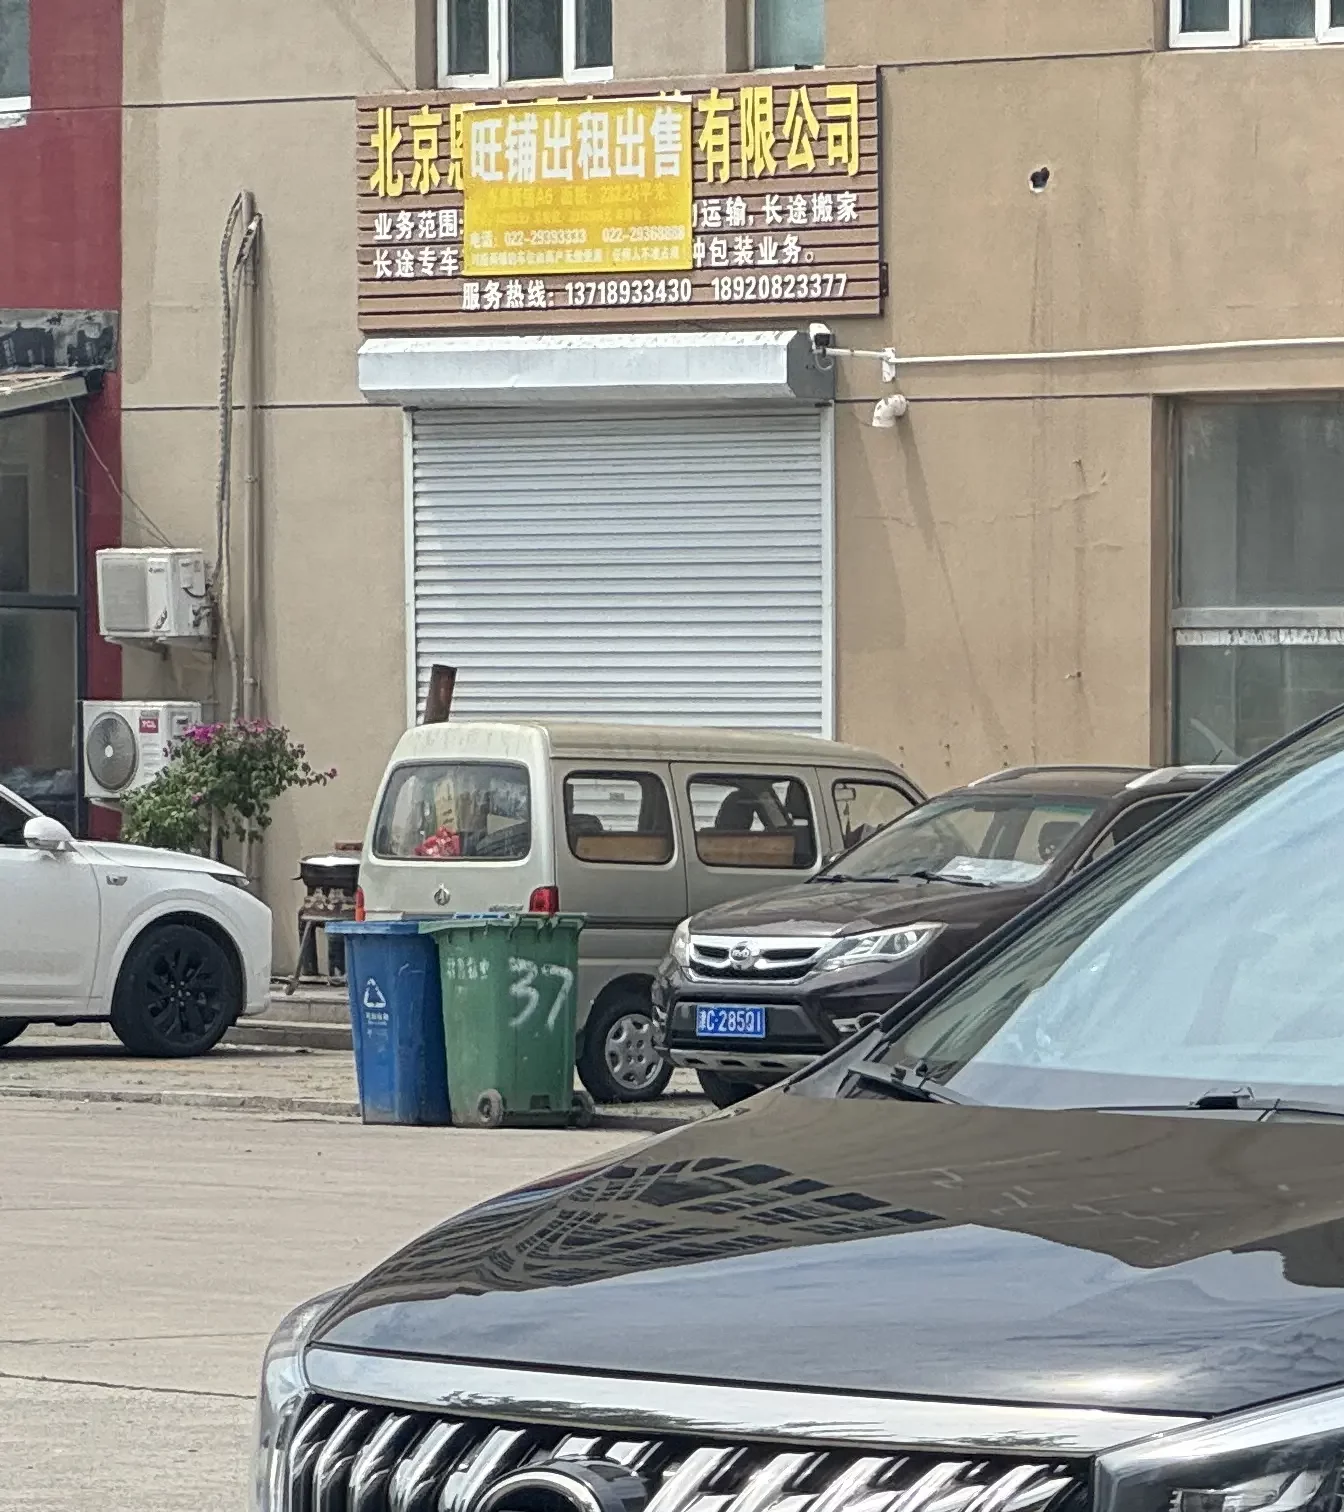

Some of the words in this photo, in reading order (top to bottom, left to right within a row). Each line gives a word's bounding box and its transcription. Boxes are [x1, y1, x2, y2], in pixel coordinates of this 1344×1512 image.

[471, 105, 683, 183] 旺铺出租出售
[698, 84, 859, 183] 有限公司
[693, 191, 859, 227] 运输,长途搬家
[373, 247, 459, 278] 长途专车
[565, 278, 692, 306] 13718933430
[711, 273, 847, 301] 18920823377
[508, 957, 574, 1030] 37
